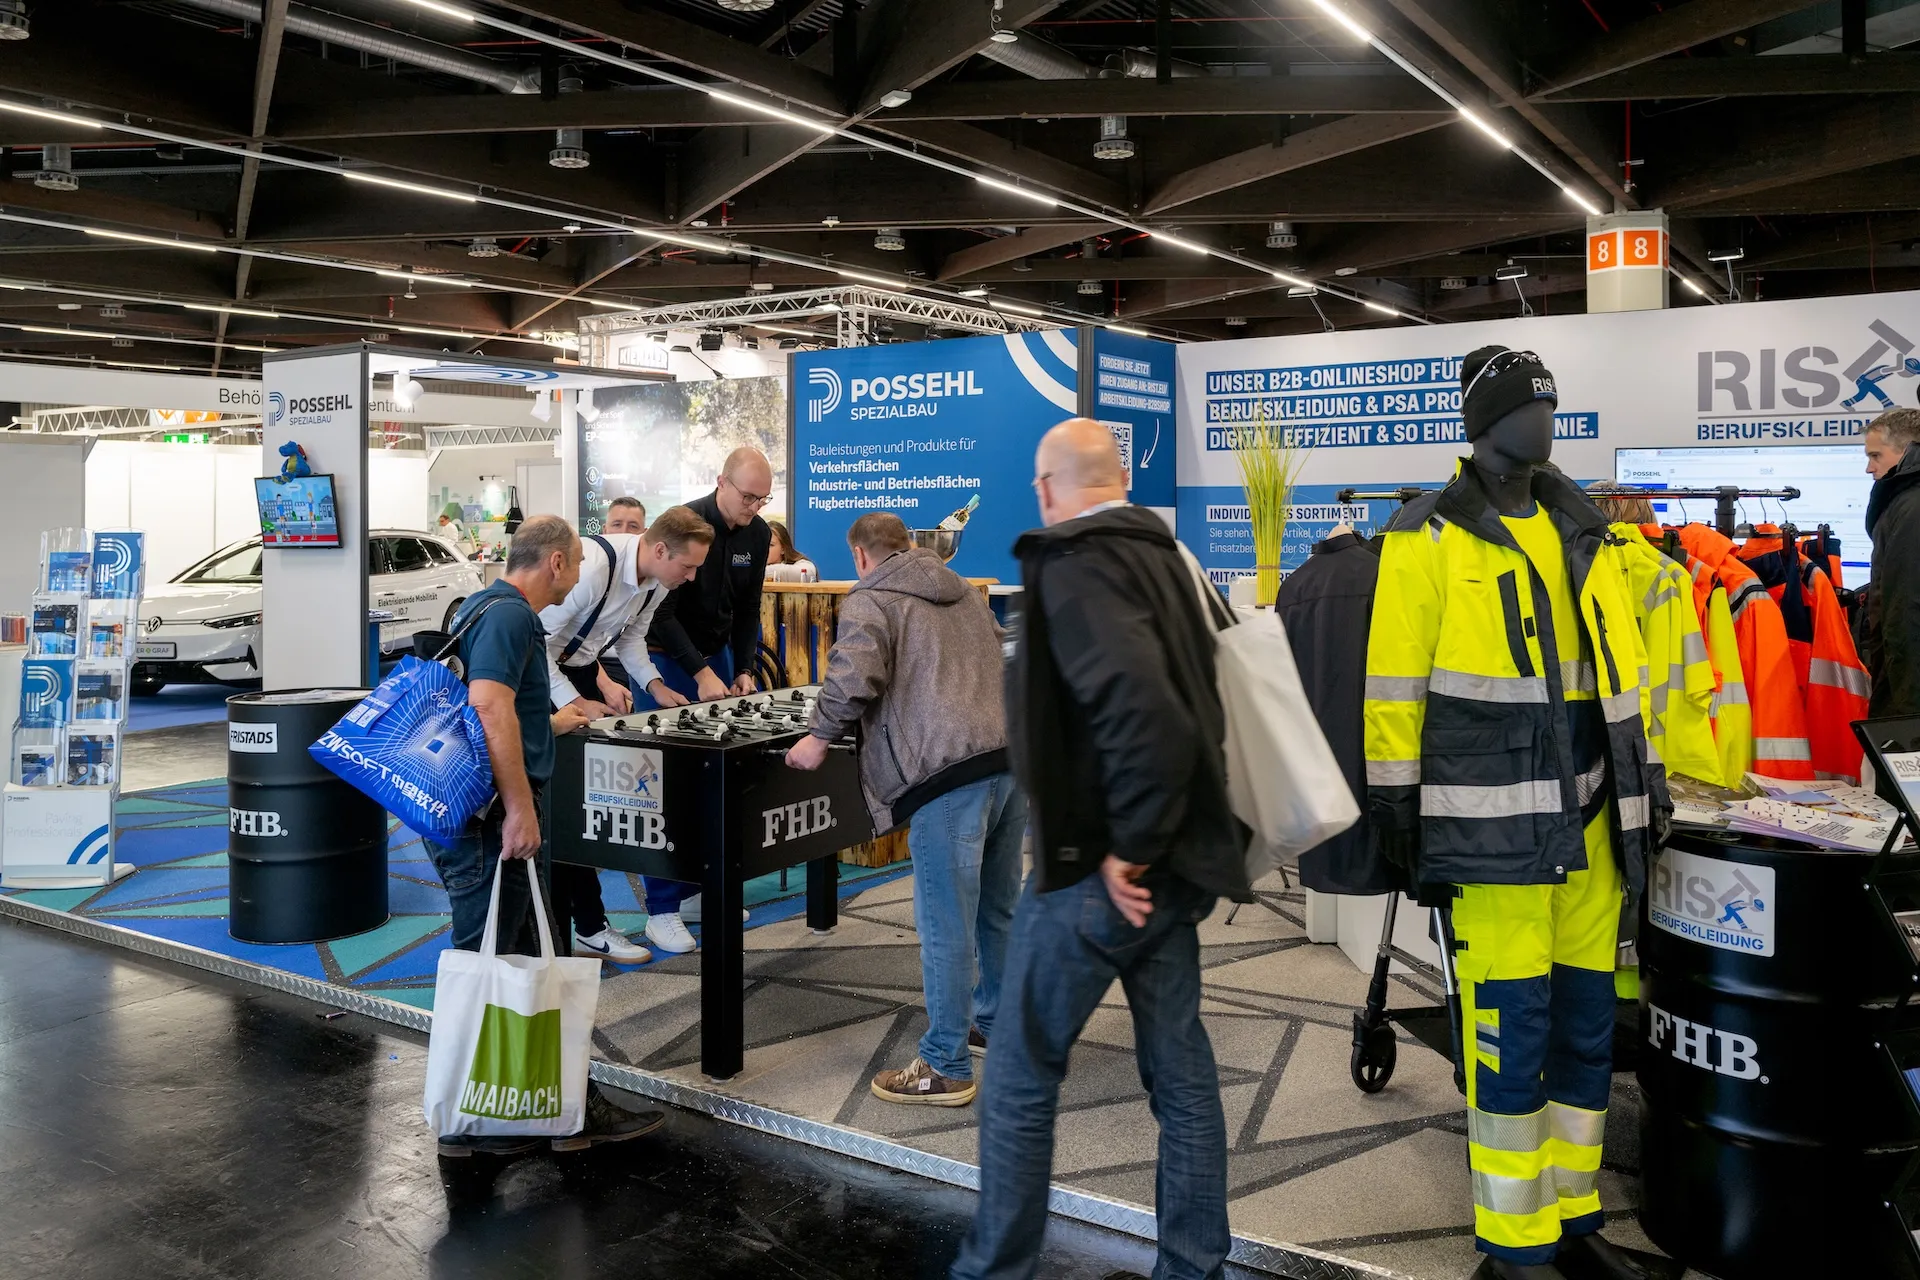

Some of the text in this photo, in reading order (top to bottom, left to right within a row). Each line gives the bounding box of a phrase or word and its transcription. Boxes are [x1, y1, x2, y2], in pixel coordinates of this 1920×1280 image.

[1598, 240, 1609, 263] 8
[1634, 236, 1648, 259] 8
[1100, 356, 1150, 375] FORDERN SIE JETZT
[850, 369, 984, 404] POSSEHL
[1100, 373, 1117, 387] IHREN
[1117, 376, 1138, 391] ZUGANG
[1209, 373, 1265, 393] UNSER
[1269, 362, 1426, 391] B2B-ONLINESHOP
[219, 388, 263, 405] Behö
[289, 394, 353, 414] POSSEHL
[1209, 390, 1463, 421] BERUFSKLEIDUNG & PSA PRO
[289, 415, 332, 426] SPEZIALBAU
[850, 402, 938, 422] SPEZIALBAU
[1282, 425, 1371, 448] EFFIZIENT
[1376, 424, 1390, 443] &
[1394, 422, 1419, 443] SO
[1423, 421, 1468, 442] EINF
[1697, 418, 1870, 441] BERUFSKLEID
[809, 437, 977, 458] Bauleistungen und Produkte für
[809, 459, 900, 474] Verkehrsflächen
[809, 475, 981, 492] Industrie- und Betriebsflächen
[809, 495, 919, 512] Flugbetriebsflächen
[1296, 507, 1365, 520] SORTIMENT
[1209, 527, 1330, 539] Sie sehen Artikel, die
[1209, 543, 1257, 553] Einsatzbere
[377, 592, 438, 607] Elektrisierende Mobilität
[230, 730, 274, 745] FRISTADS
[316, 730, 392, 780] ZWSOFT
[588, 792, 659, 810] BERUFSKLEIDUNG
[1651, 909, 1764, 951] BERUFSKLEIDUNG
[461, 1079, 559, 1118] MAIBACH
